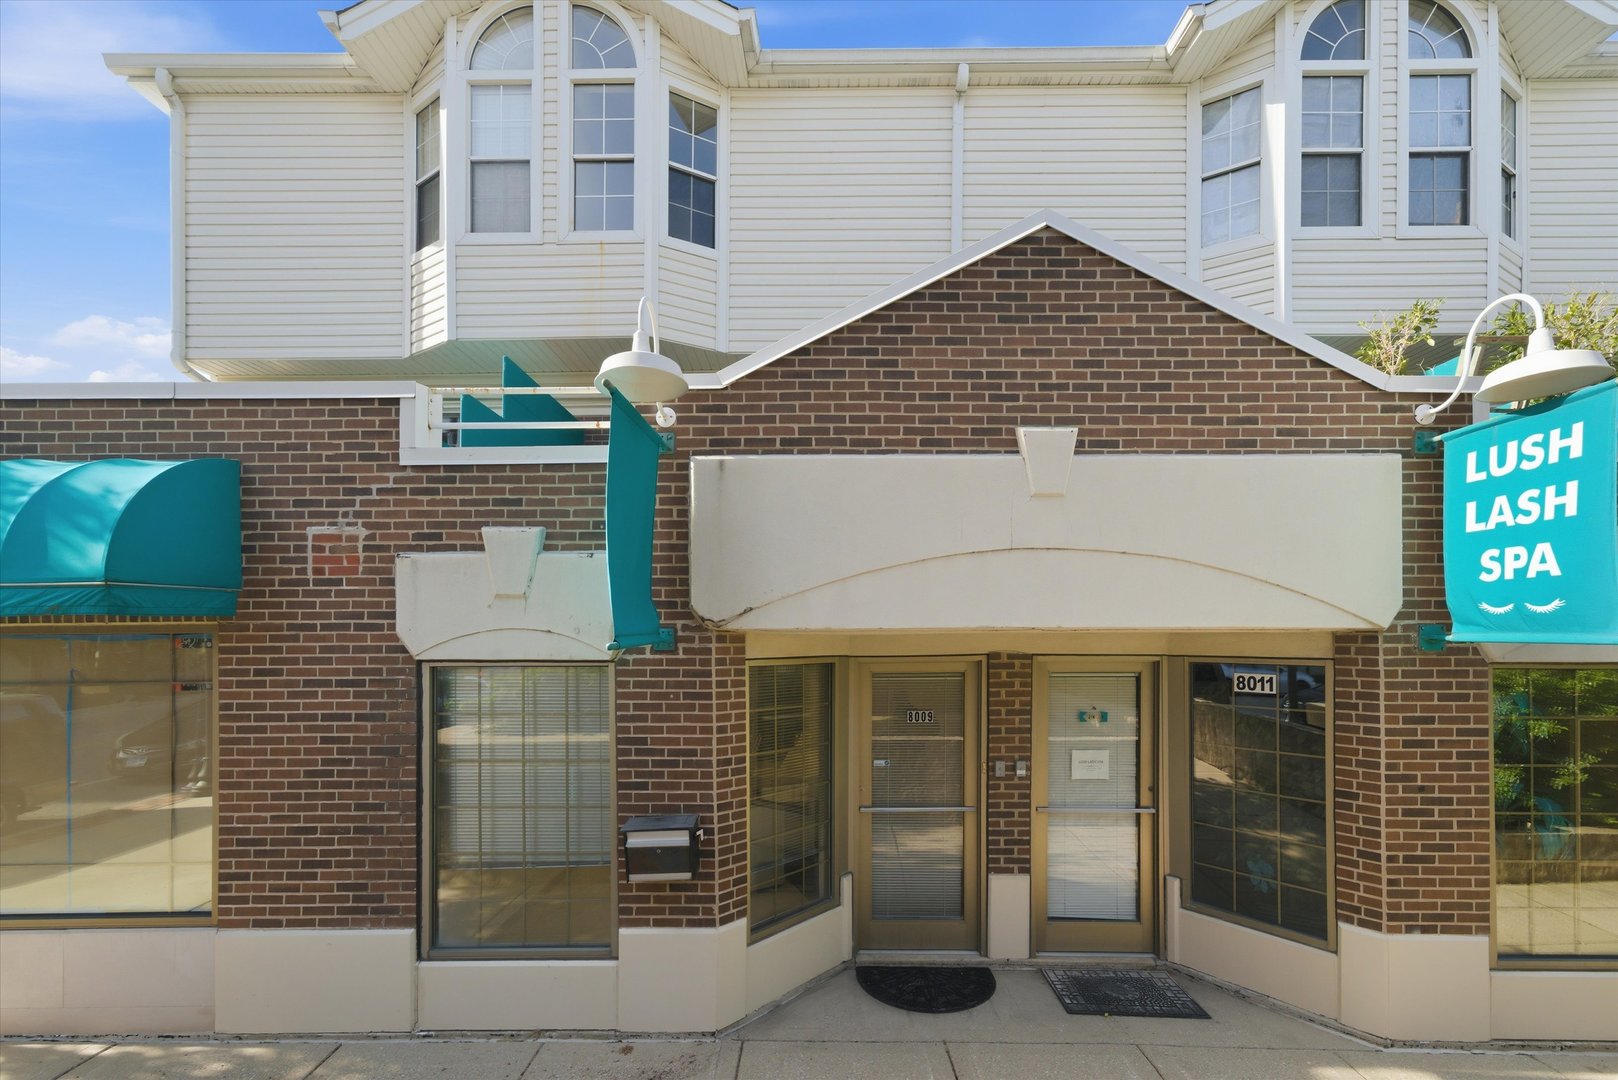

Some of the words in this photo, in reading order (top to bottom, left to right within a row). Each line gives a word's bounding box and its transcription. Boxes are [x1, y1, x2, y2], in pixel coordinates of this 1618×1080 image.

[1465, 421, 1584, 483] LUSH
[1465, 480, 1579, 533] LASH
[1478, 542, 1562, 583] SPA
[1236, 675, 1274, 692] 8011
[907, 711, 933, 722] 8009
